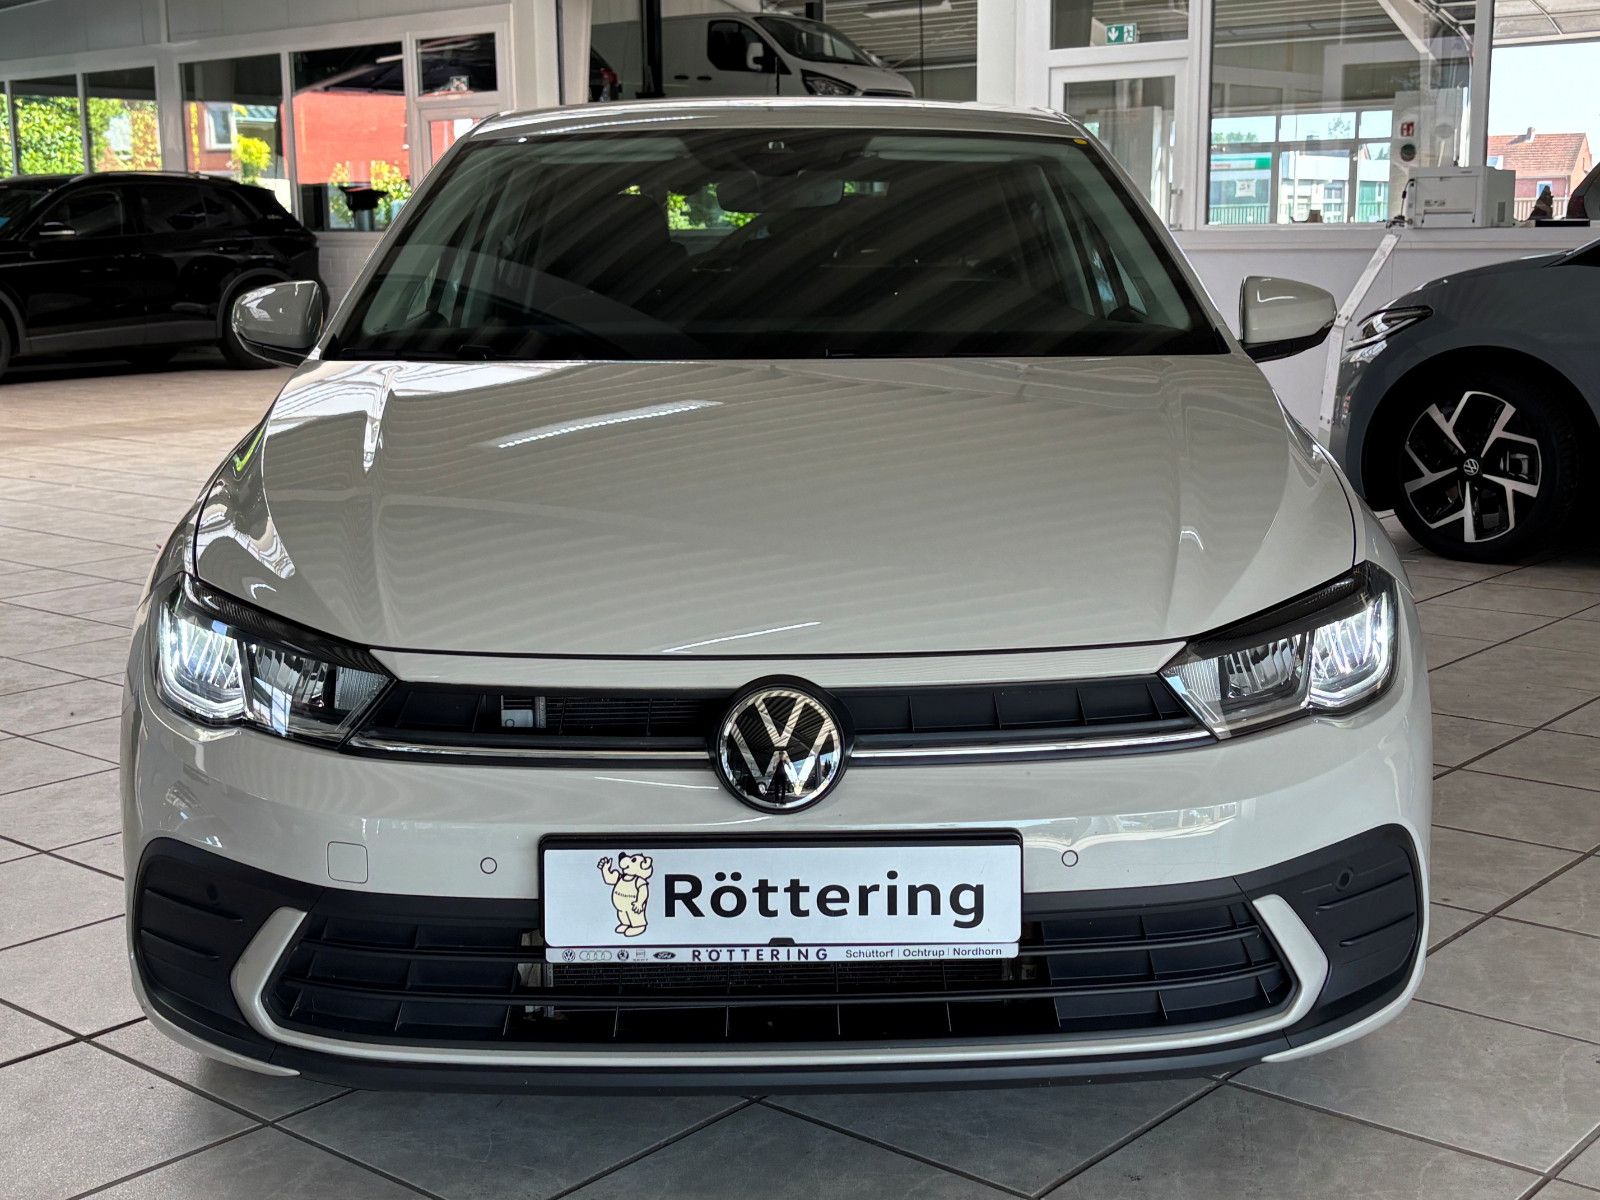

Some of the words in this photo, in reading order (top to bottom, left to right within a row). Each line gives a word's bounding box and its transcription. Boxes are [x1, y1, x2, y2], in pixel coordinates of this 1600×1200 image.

[664, 870, 985, 928] Röttering
[691, 948, 828, 962] RÖTTERING
[845, 948, 894, 959] Schüttorf
[902, 947, 945, 959] Ochtrup
[953, 946, 1002, 957] Nordhorn
